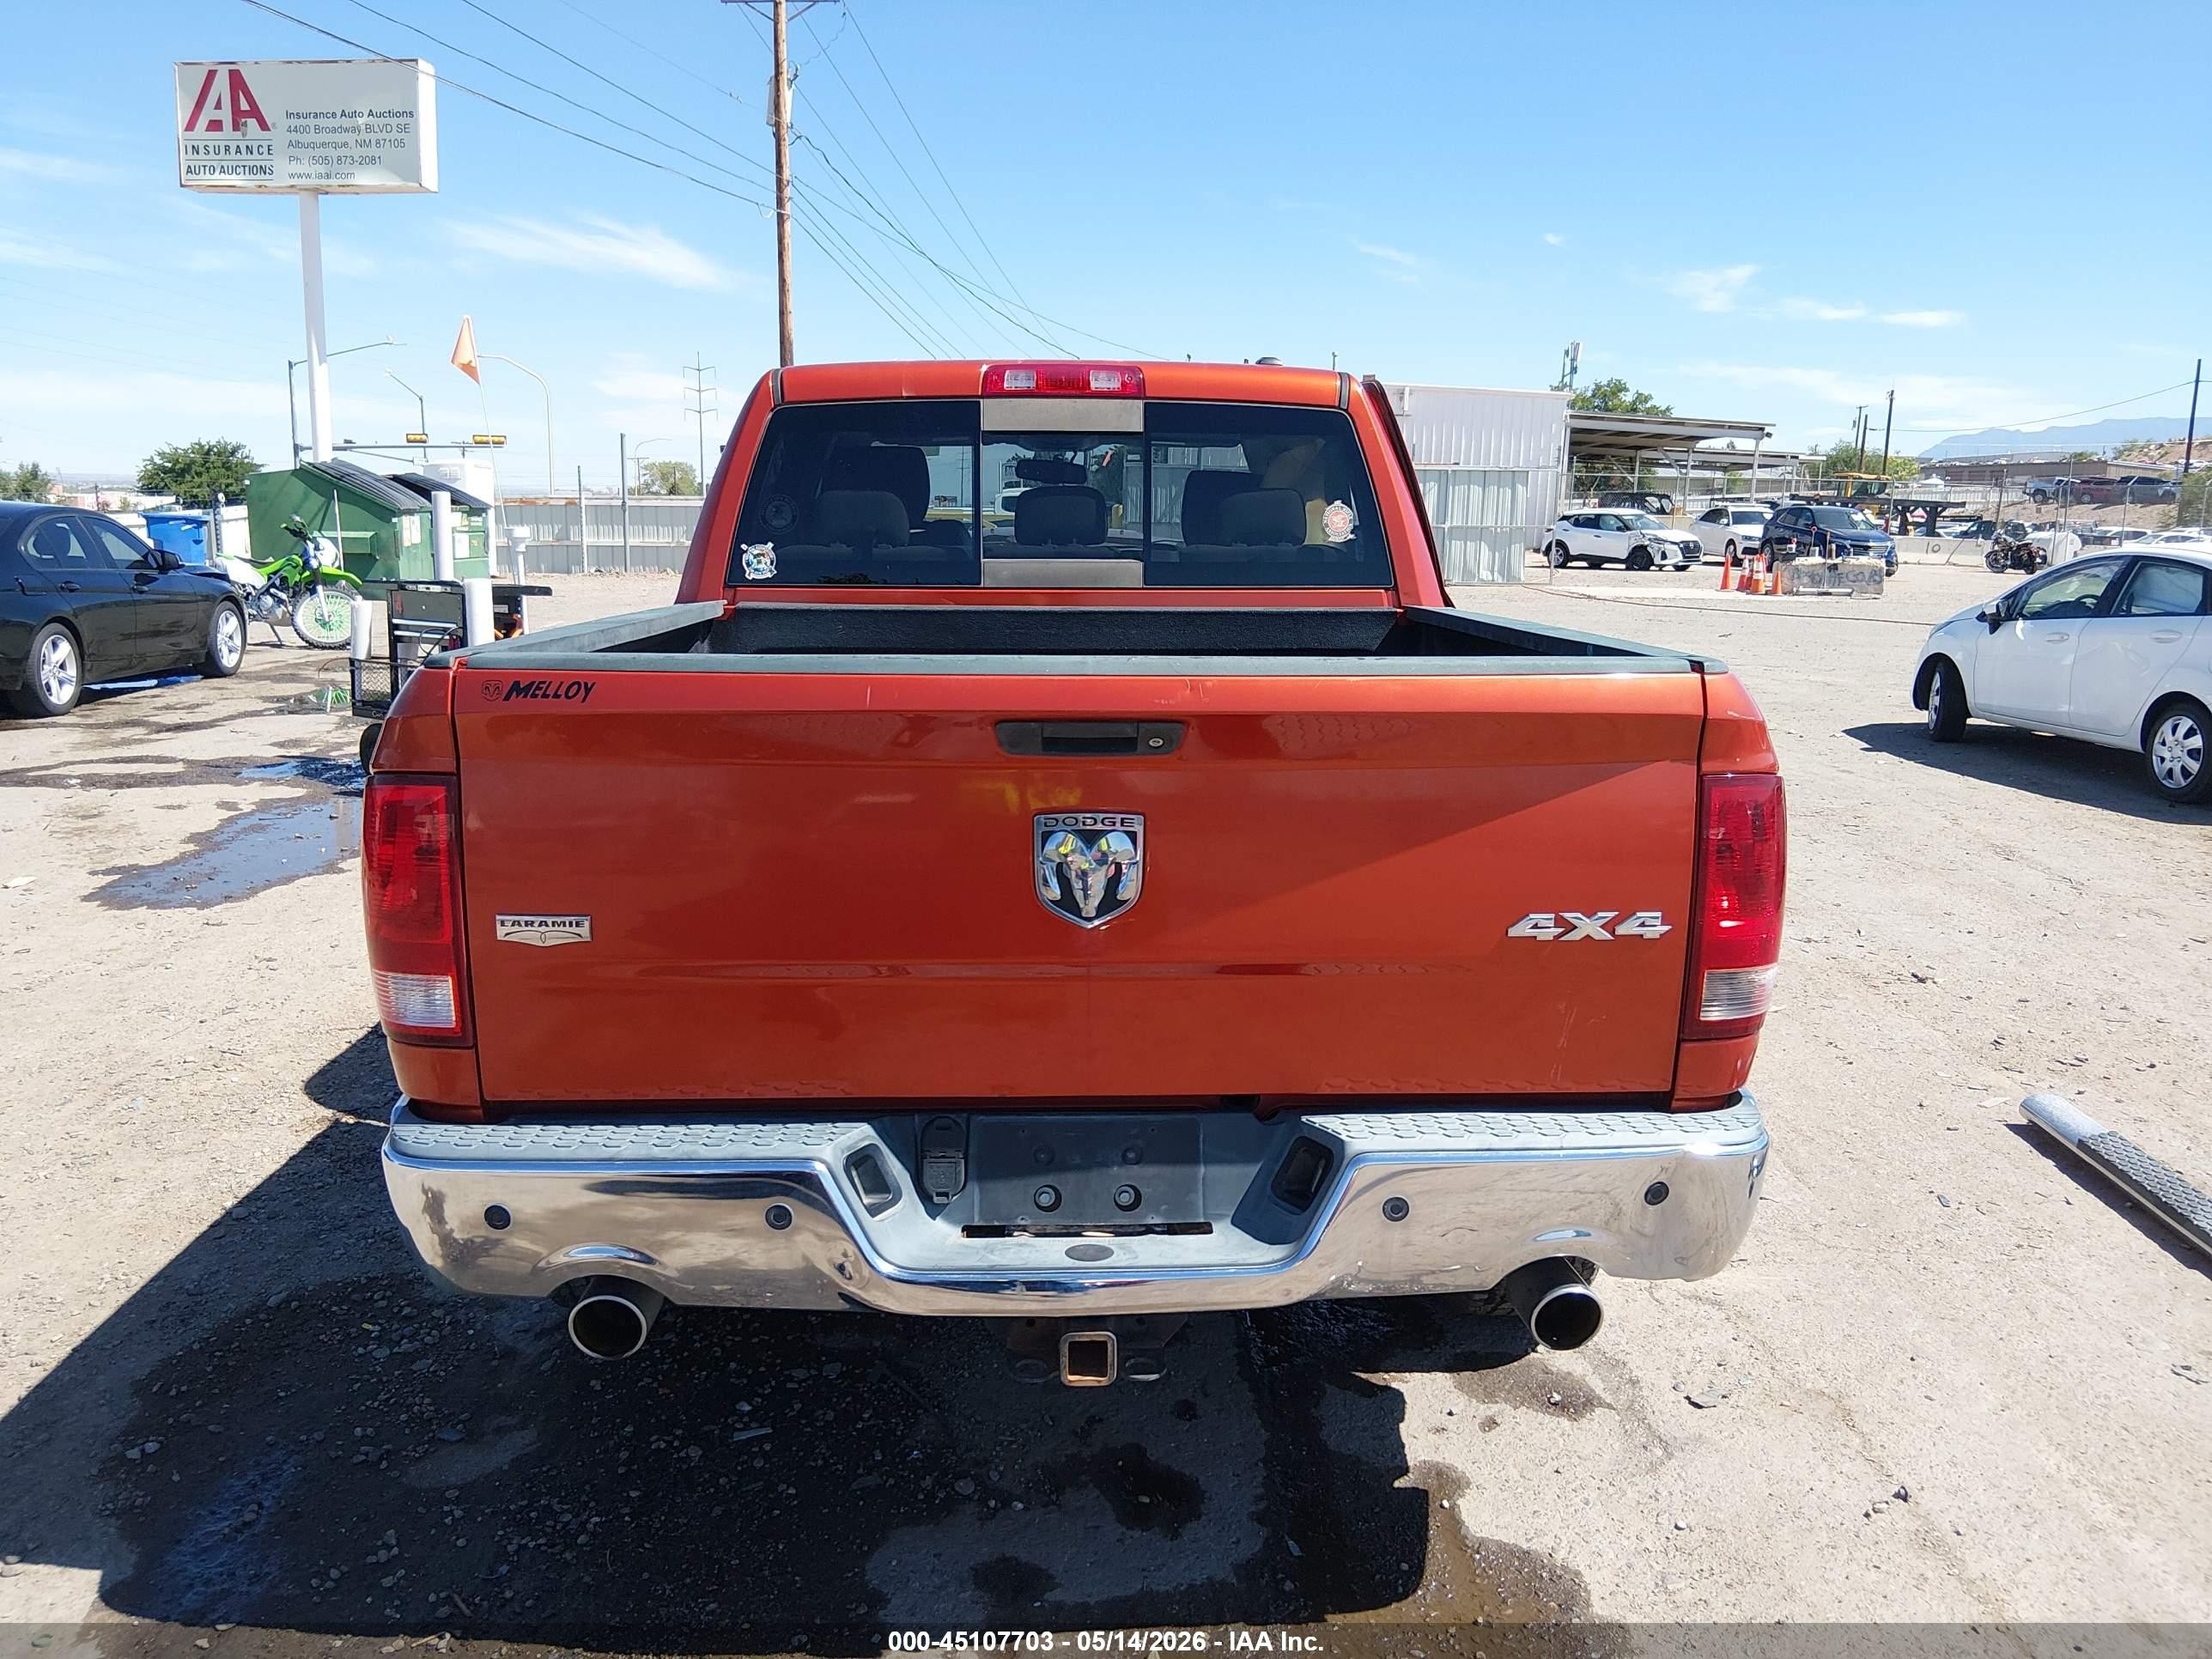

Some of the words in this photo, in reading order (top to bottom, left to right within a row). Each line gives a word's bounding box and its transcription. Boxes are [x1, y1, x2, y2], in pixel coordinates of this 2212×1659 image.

[285, 109, 337, 120] Insurance
[340, 109, 364, 119] Auto
[367, 108, 415, 118] Auctions
[286, 124, 311, 135] 4400
[314, 124, 362, 136] Broadway
[365, 123, 393, 134] BLVD
[396, 123, 410, 134] SE
[185, 144, 274, 155] INSURANCE
[288, 139, 352, 151] Albuquerque,
[355, 138, 372, 149] NM
[374, 138, 406, 149] 87105
[289, 155, 305, 166] Ph:
[307, 155, 334, 167] (505)
[337, 155, 382, 166] 873-2081
[185, 164, 216, 175] AUTO
[219, 164, 274, 175] AUCTIONS
[288, 171, 356, 180] www.iaai.com
[1925, 542, 1941, 554] 10
[502, 680, 597, 703] MELLOY
[1043, 817, 1136, 828] DODGE
